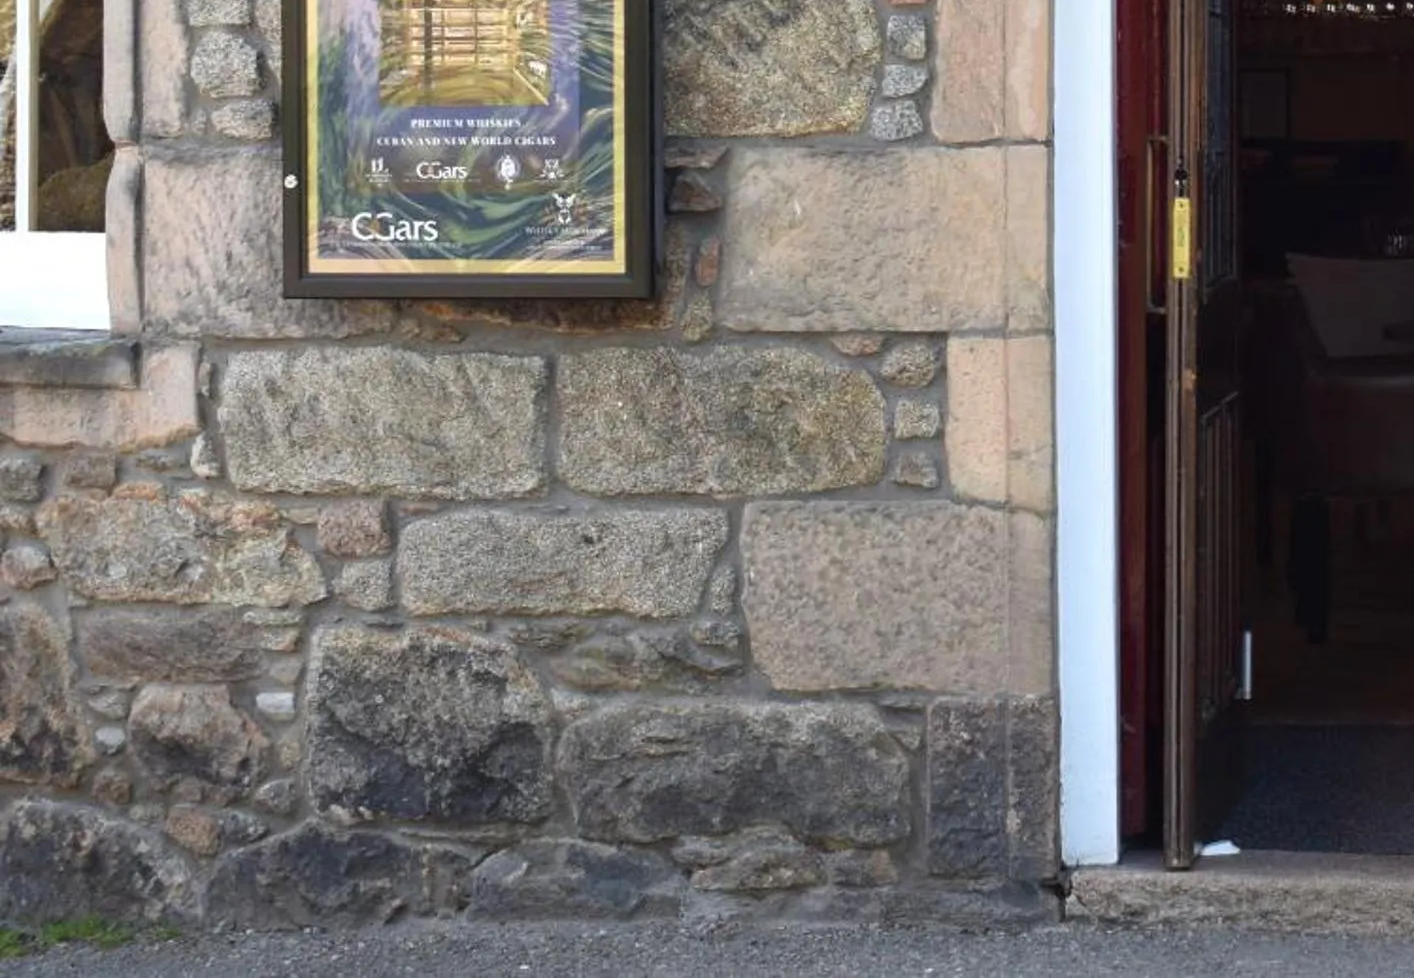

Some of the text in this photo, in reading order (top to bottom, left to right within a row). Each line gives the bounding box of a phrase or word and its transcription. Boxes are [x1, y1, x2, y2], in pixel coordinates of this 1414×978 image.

[410, 119, 463, 129] PREMIUM
[376, 135, 556, 147] CUBAN AND NEW WORLD CIGARS
